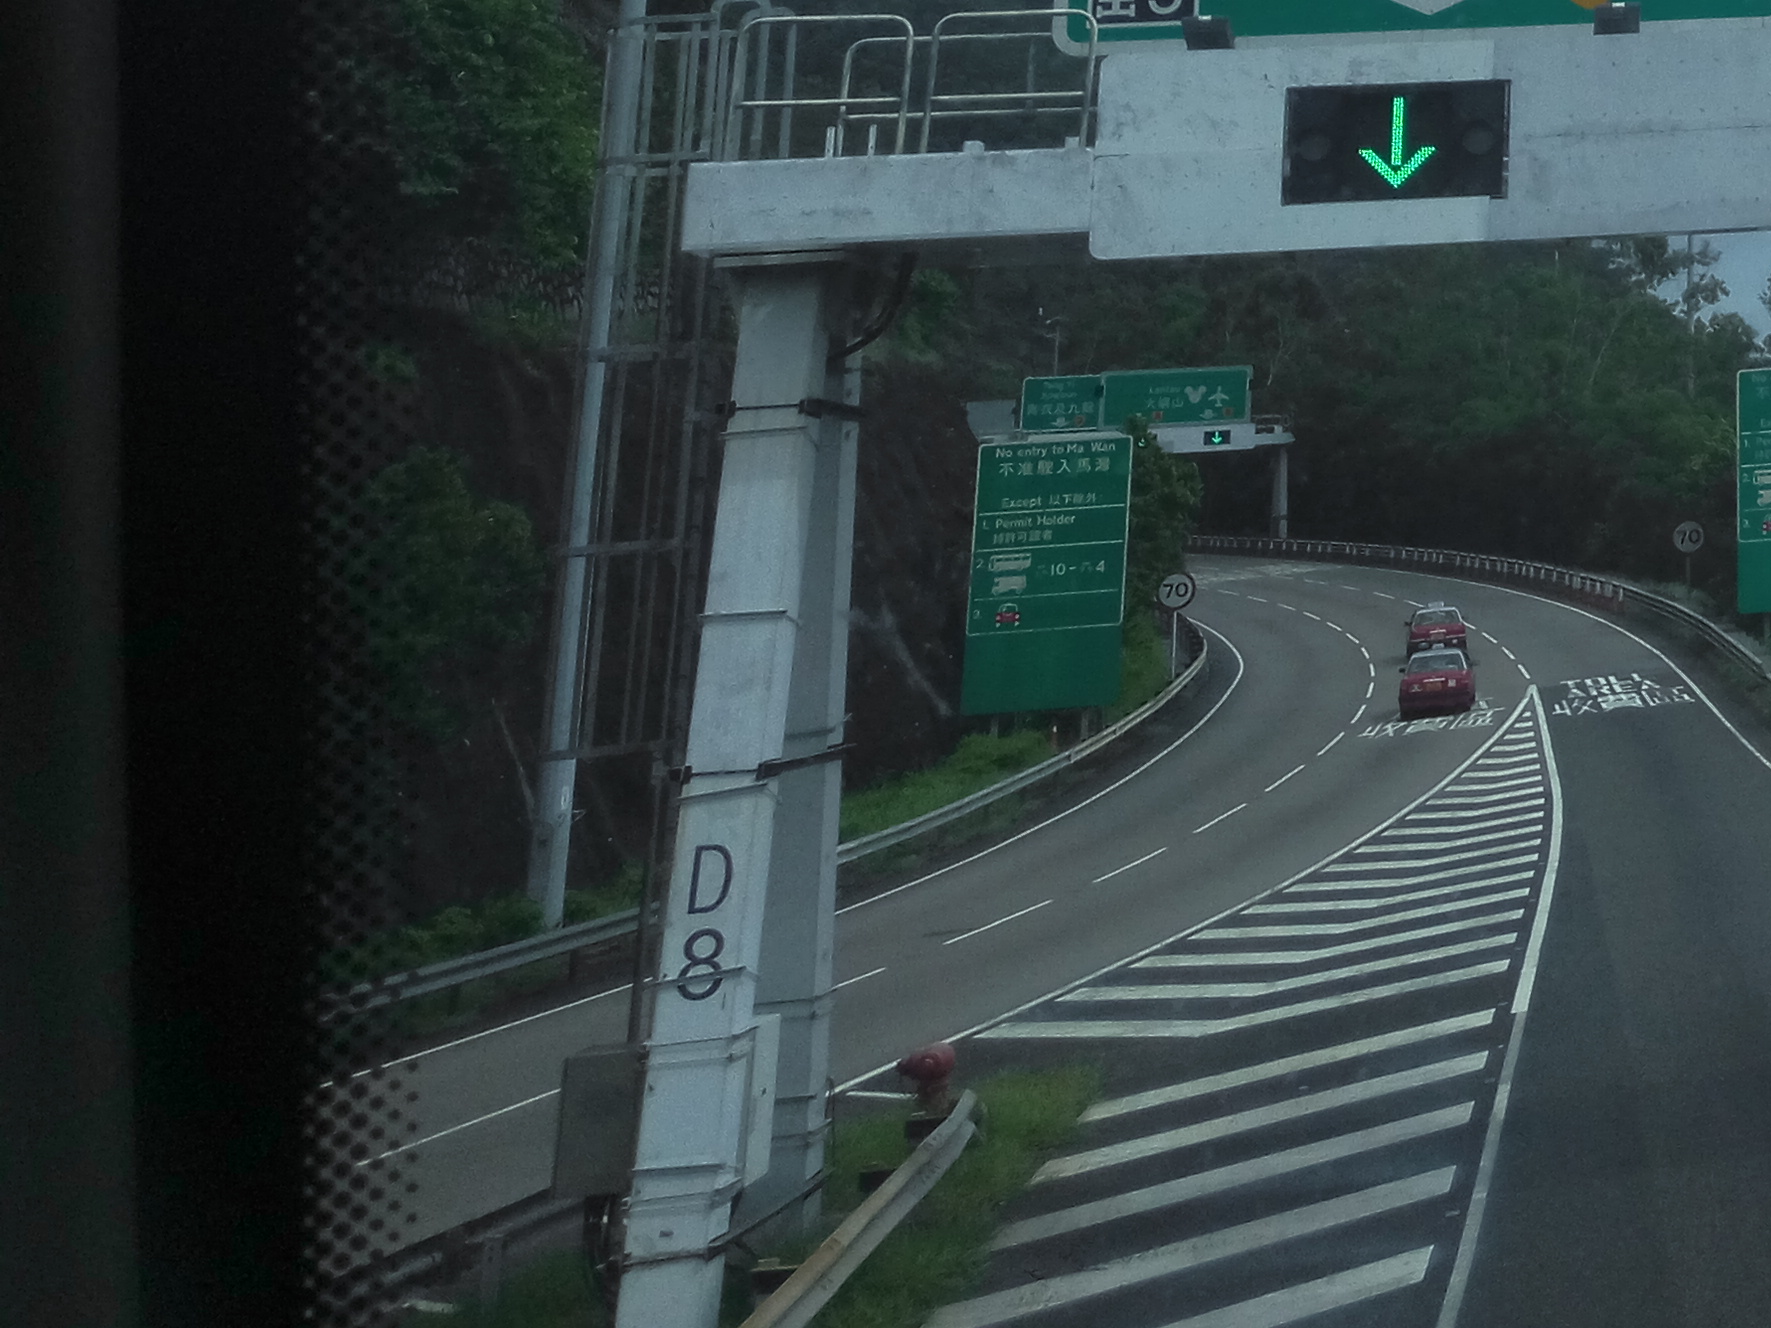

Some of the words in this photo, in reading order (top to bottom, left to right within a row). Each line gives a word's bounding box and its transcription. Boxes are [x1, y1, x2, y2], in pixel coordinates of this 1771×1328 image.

[995, 447, 1013, 458] No
[1017, 446, 1048, 458] entry
[1052, 444, 1065, 455] to
[1066, 443, 1084, 454] Ma
[1090, 442, 1116, 453] Wan
[1001, 496, 1042, 509] Except
[995, 516, 1033, 529] Permit
[1036, 514, 1077, 526] Holder
[1676, 529, 1701, 545] 70
[1162, 582, 1188, 599] 70
